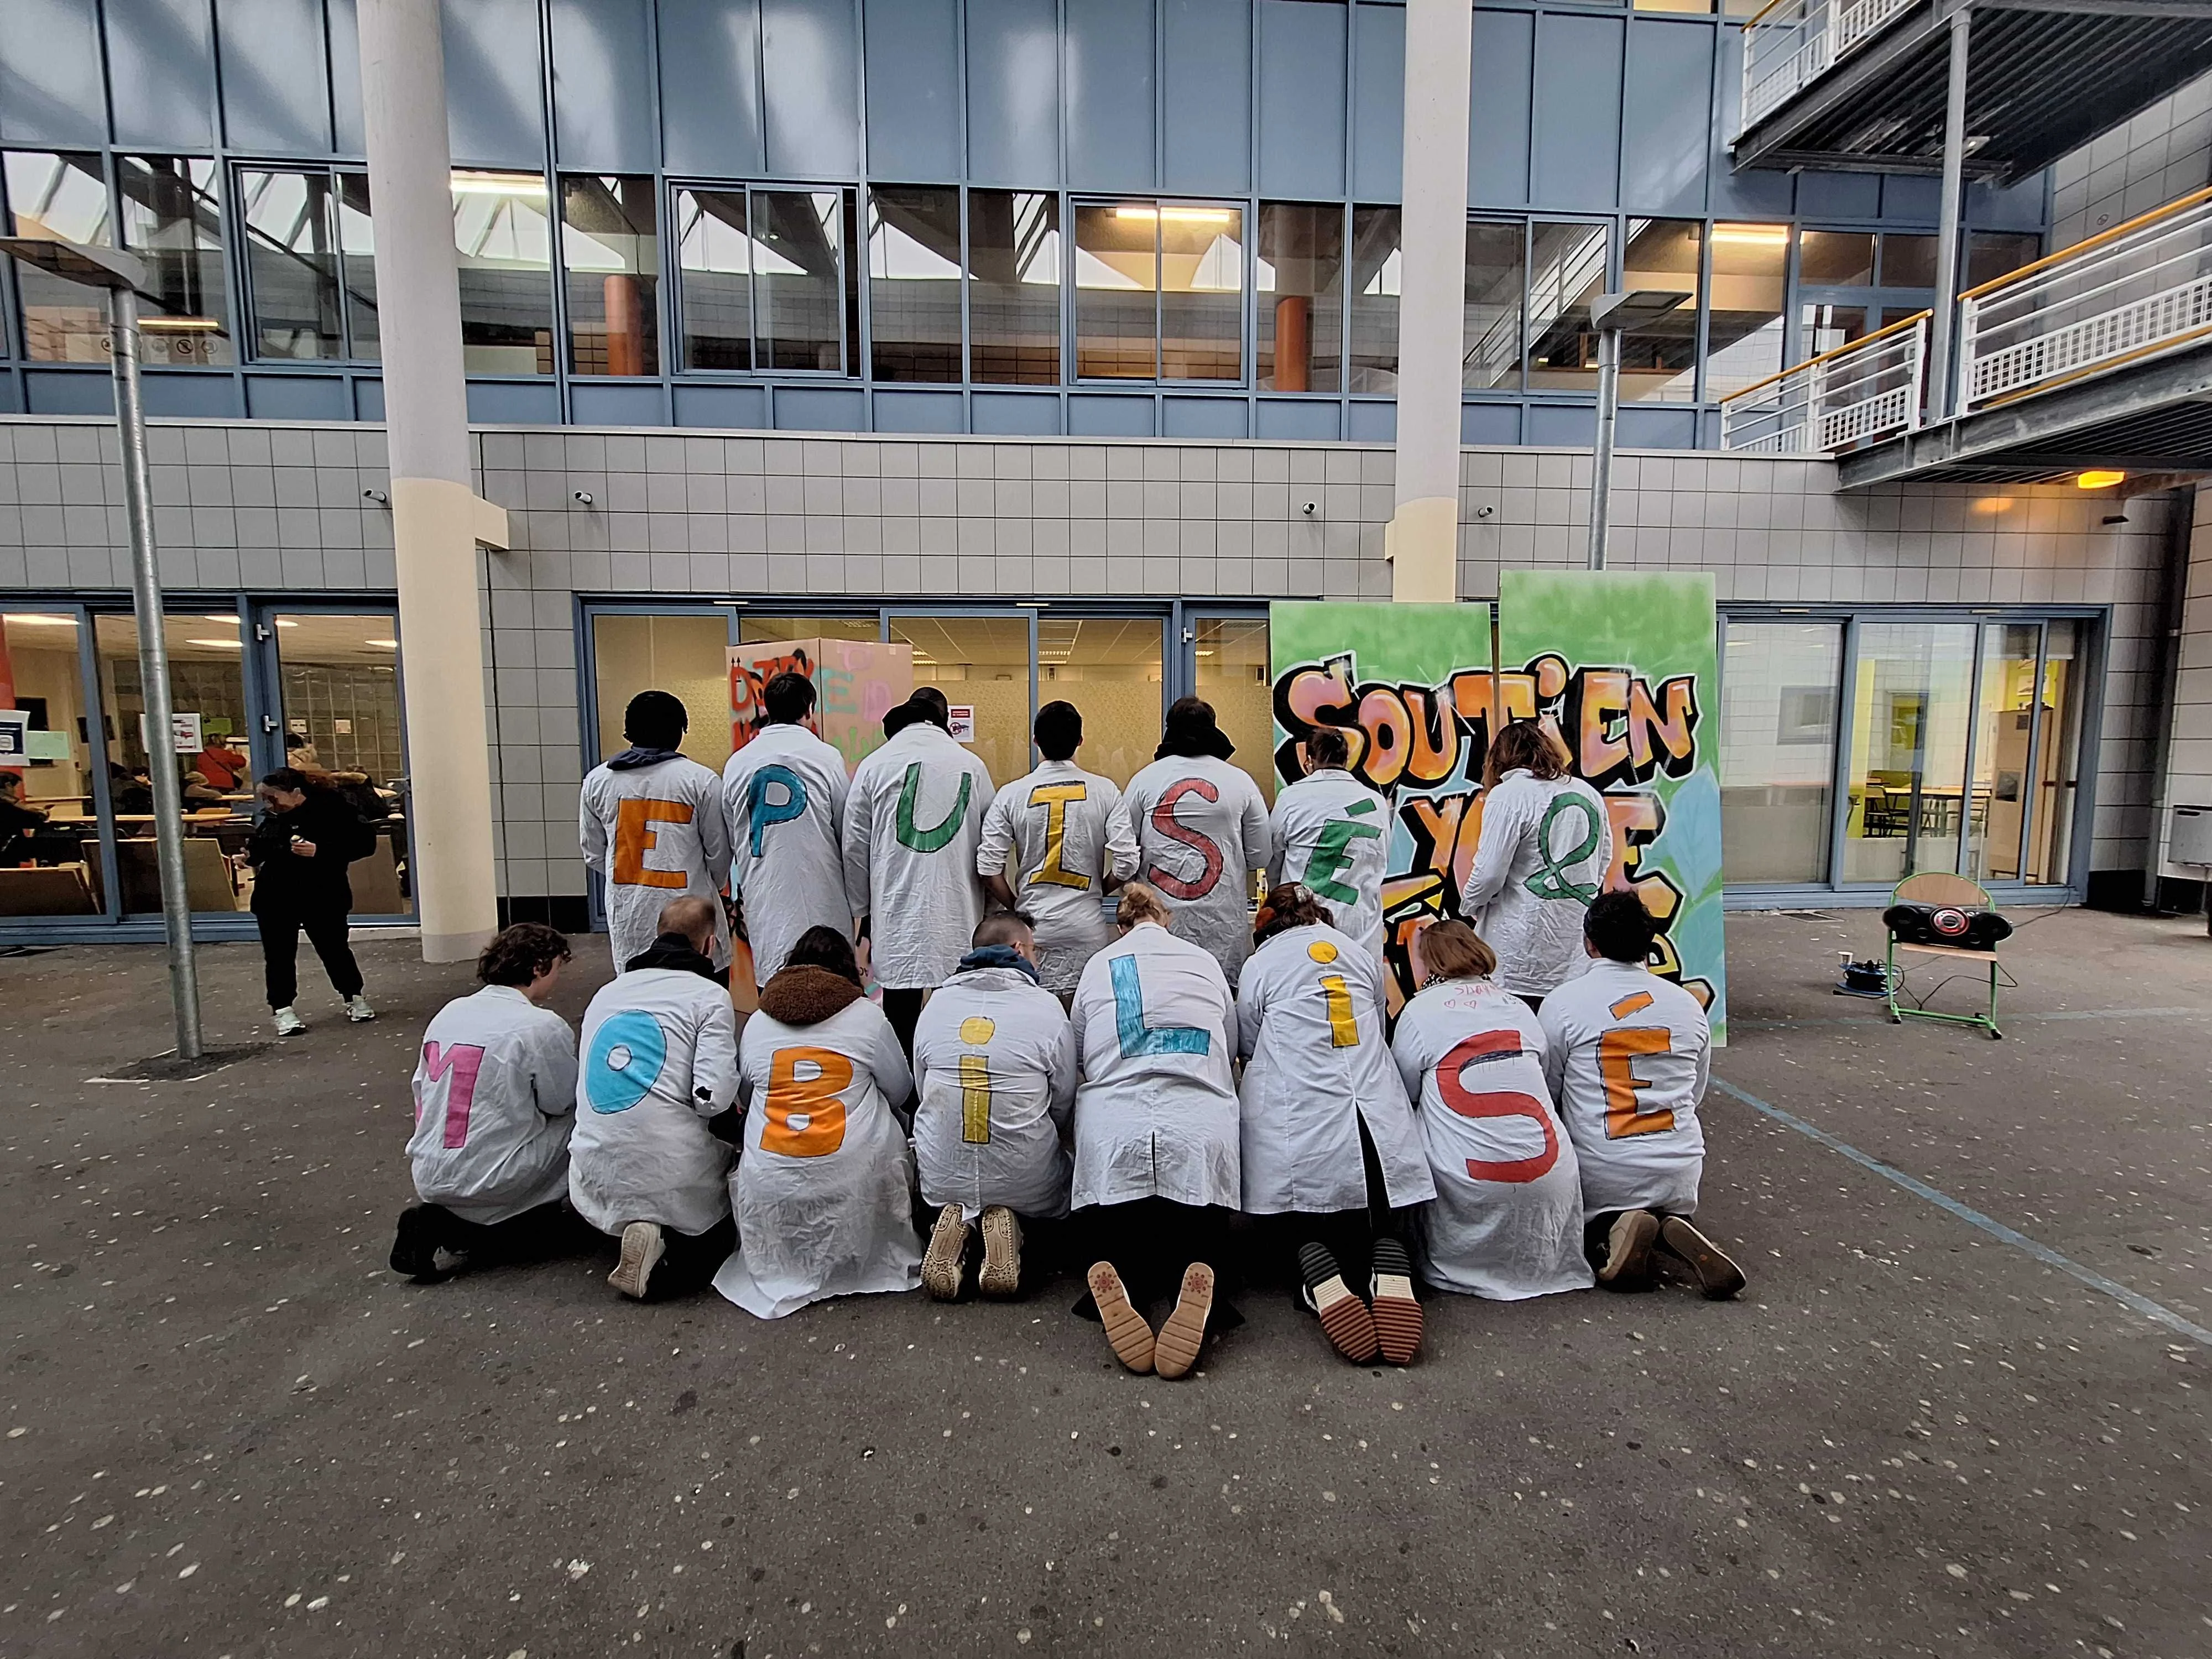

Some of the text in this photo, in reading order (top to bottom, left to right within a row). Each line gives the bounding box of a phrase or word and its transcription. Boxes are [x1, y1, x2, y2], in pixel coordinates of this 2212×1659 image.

[613, 797, 695, 889] E
[746, 764, 808, 859] P
[895, 761, 972, 854] U
[1027, 780, 1092, 892] I
[1146, 777, 1224, 901] S
[1300, 798, 1383, 906] É
[415, 1041, 486, 1149] M
[585, 1008, 667, 1115] O
[759, 1045, 853, 1158] B
[1108, 953, 1211, 1060] L
[1437, 1029, 1559, 1184] S
[1597, 990, 1677, 1141] É
